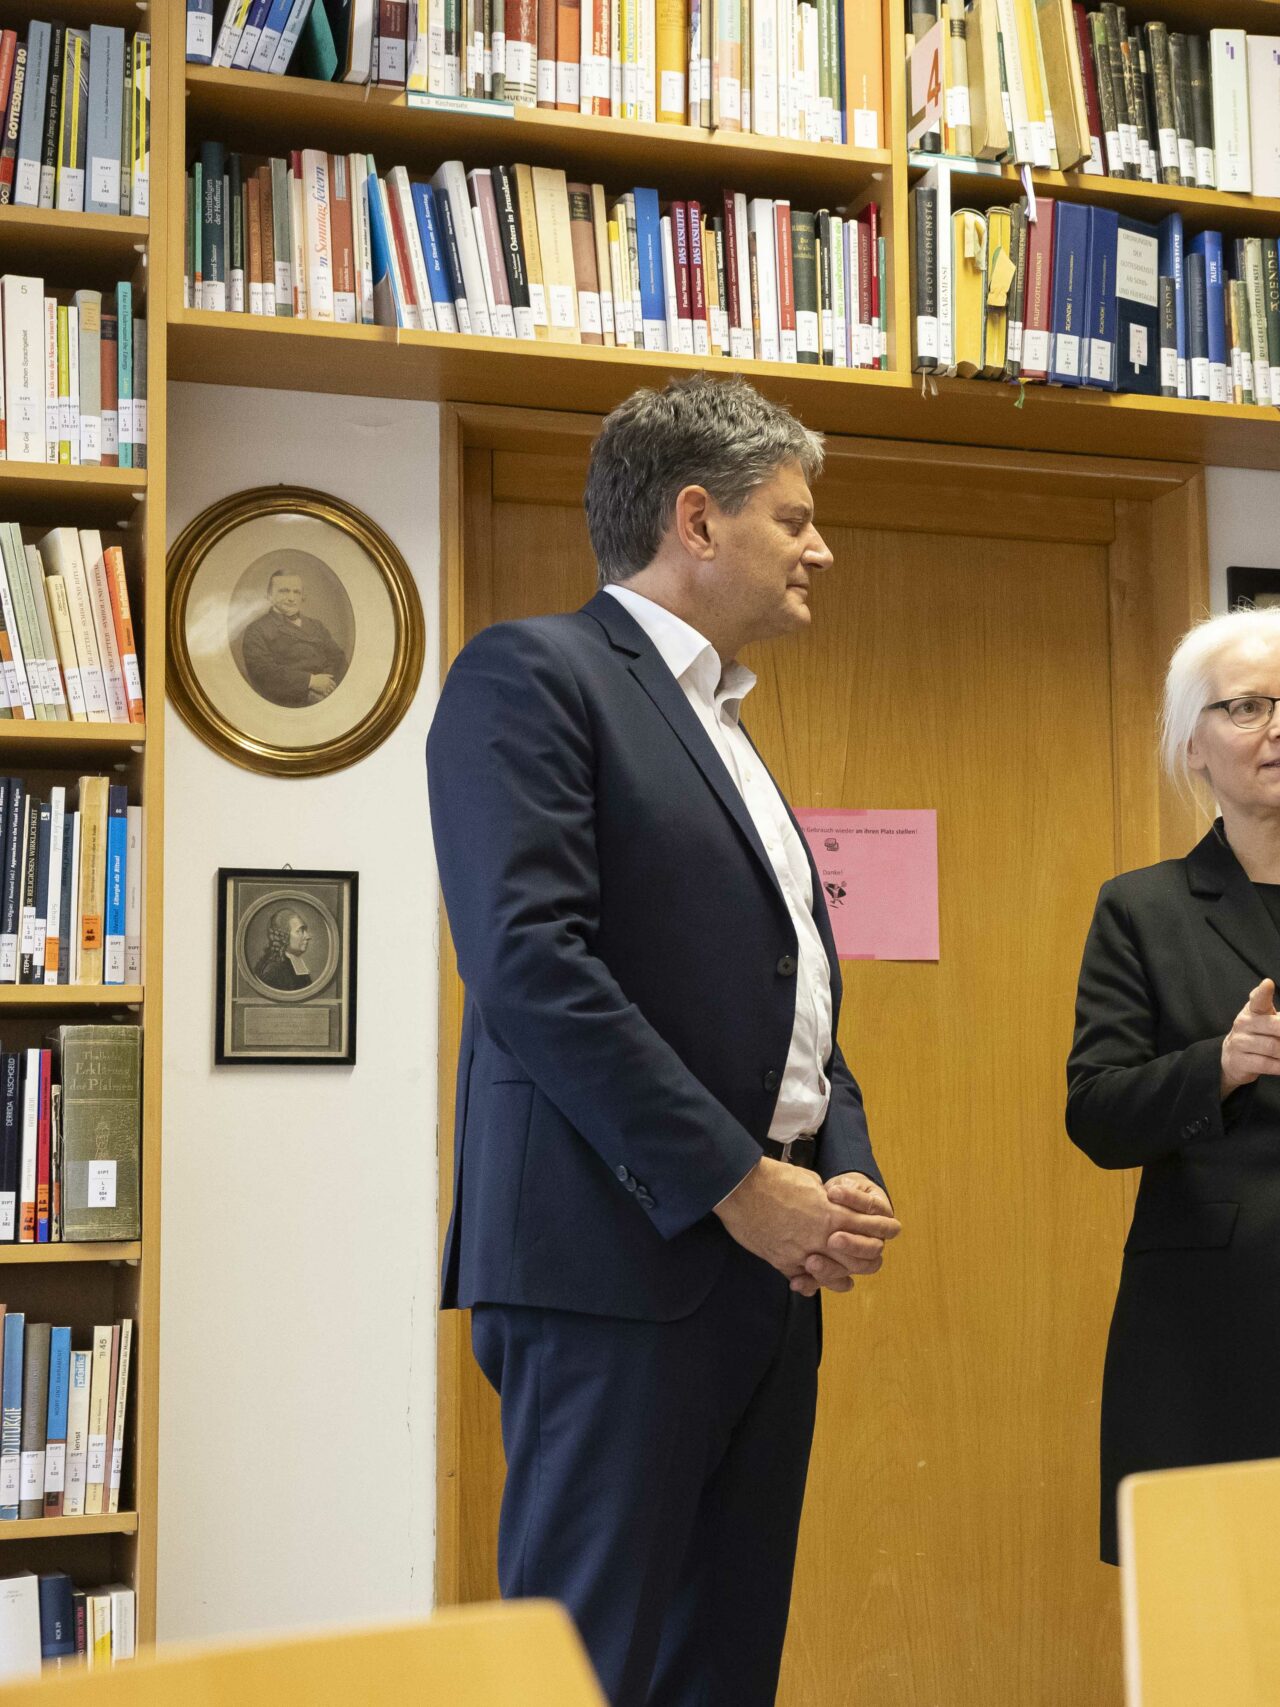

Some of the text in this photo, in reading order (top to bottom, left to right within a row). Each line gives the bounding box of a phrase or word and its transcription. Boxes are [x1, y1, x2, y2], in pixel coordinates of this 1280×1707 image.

[7, 48, 27, 140] GOTTESDIENST 80
[50, 75, 59, 94] Liturgy
[50, 99, 58, 108] and
[49, 109, 57, 118] the
[205, 179, 214, 224] Schrittfolgen
[213, 179, 222, 212] Hoffnung
[312, 166, 328, 253] Sonntag feiern
[422, 193, 432, 218] Sonntag
[501, 175, 513, 213] Jerusalem
[506, 214, 514, 223] in
[675, 207, 687, 265] DAS EXSULTET
[690, 207, 702, 265] DAS EXSULTET
[508, 225, 518, 252] Ostern
[922, 201, 934, 294] GOTTESDIENSTE
[20, 284, 27, 294] 5
[1033, 252, 1042, 327] HAUPTGOTTESDIENST
[1209, 261, 1217, 283] TAUFE
[1267, 249, 1280, 312] AGENDE
[26, 809, 38, 897] RELIGIÖSEN WIRKLICHKEIT
[113, 856, 121, 906] Liturgie als Ritual
[7, 1058, 15, 1097] FALSCHGELD
[99, 1339, 107, 1351] 45
[3, 1407, 21, 1446] LITURGIE
